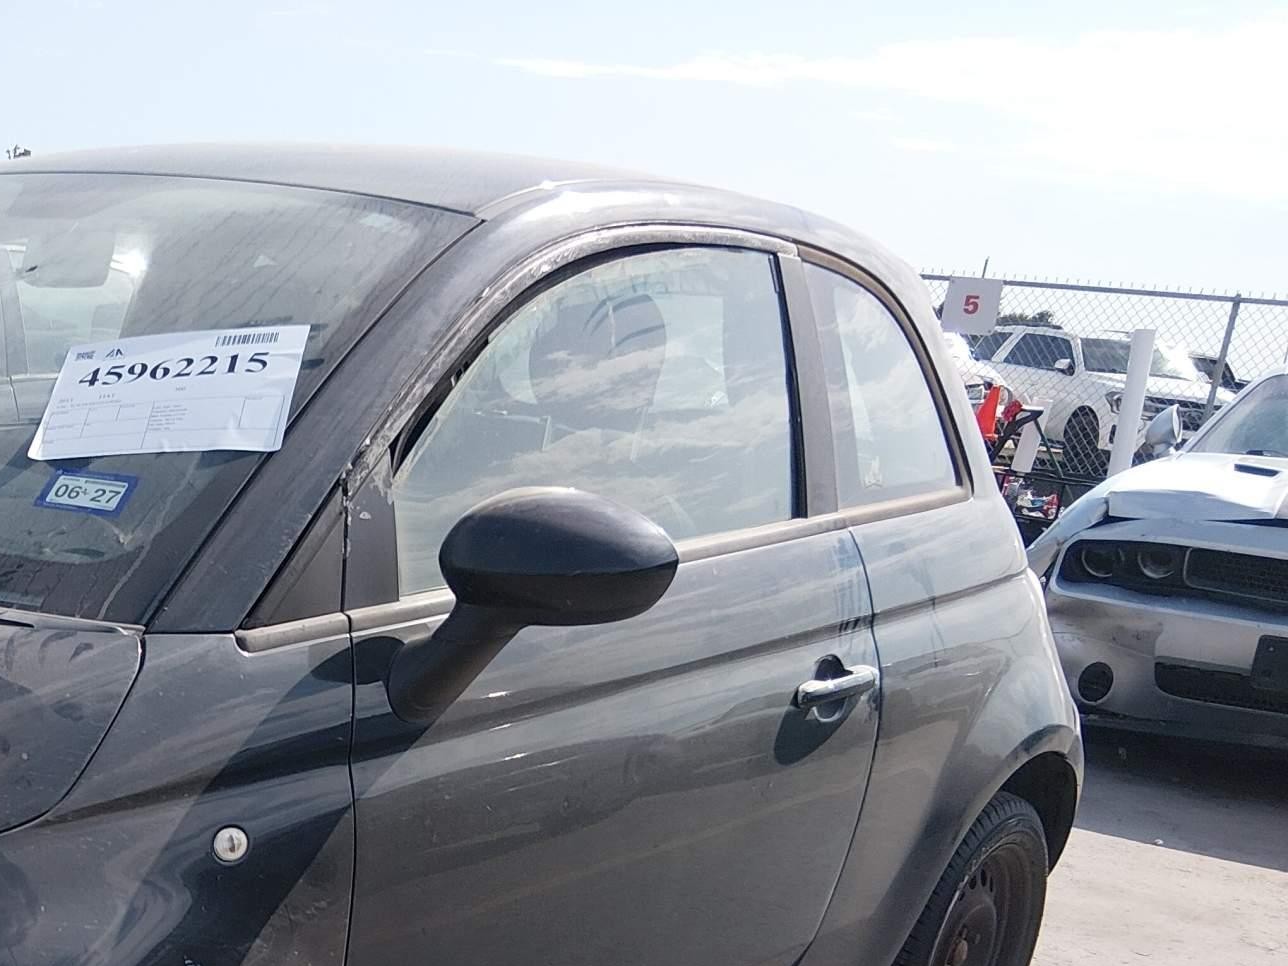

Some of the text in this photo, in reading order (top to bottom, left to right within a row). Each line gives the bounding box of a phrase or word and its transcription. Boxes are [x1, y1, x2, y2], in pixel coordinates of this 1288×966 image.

[963, 295, 980, 314] 5
[79, 352, 269, 387] 45962215
[54, 483, 82, 500] 06
[89, 487, 122, 503] 27
